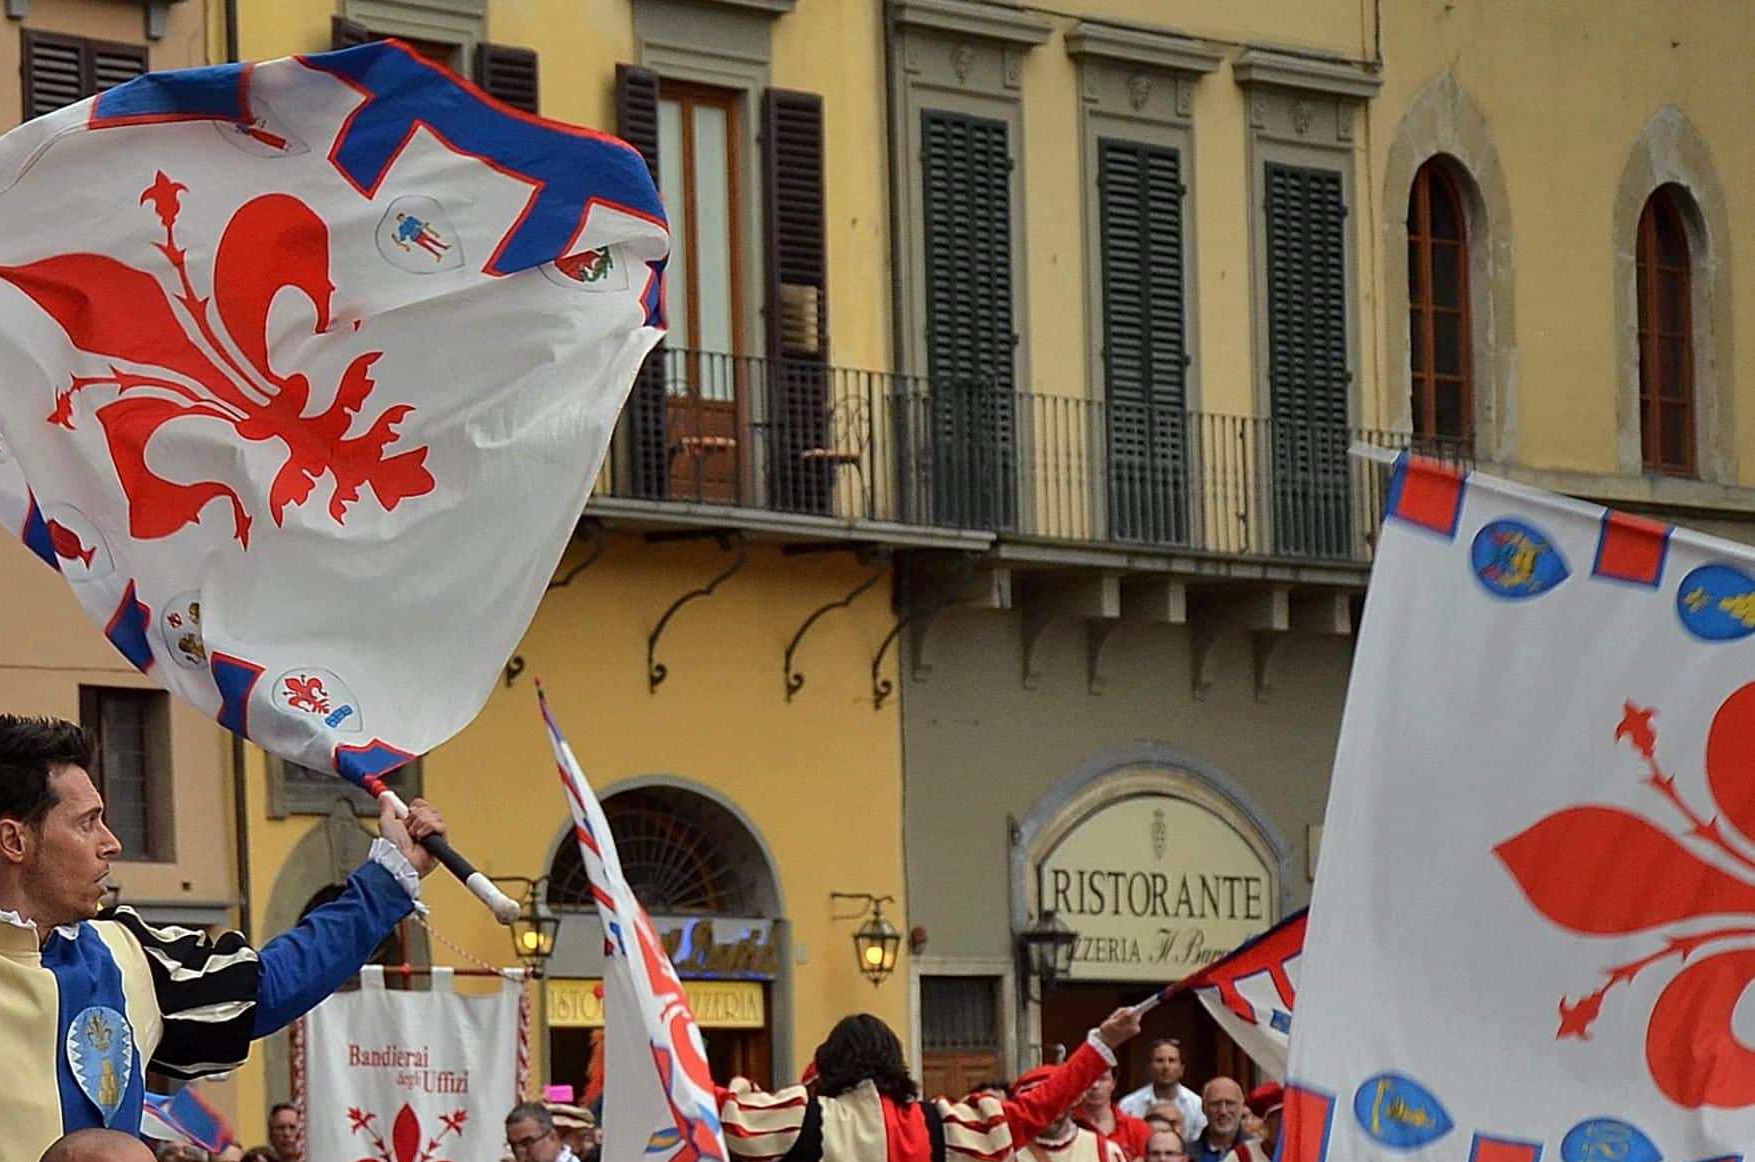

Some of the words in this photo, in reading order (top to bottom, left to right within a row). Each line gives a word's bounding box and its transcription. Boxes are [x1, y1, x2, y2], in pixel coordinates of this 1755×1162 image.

[1052, 869, 1263, 920] RISTORANTE
[1072, 936, 1142, 963] ZZERIA
[693, 991, 760, 1021] ZZERIA
[348, 1043, 429, 1068] Bandierai
[422, 1069, 469, 1094] Uffizi
